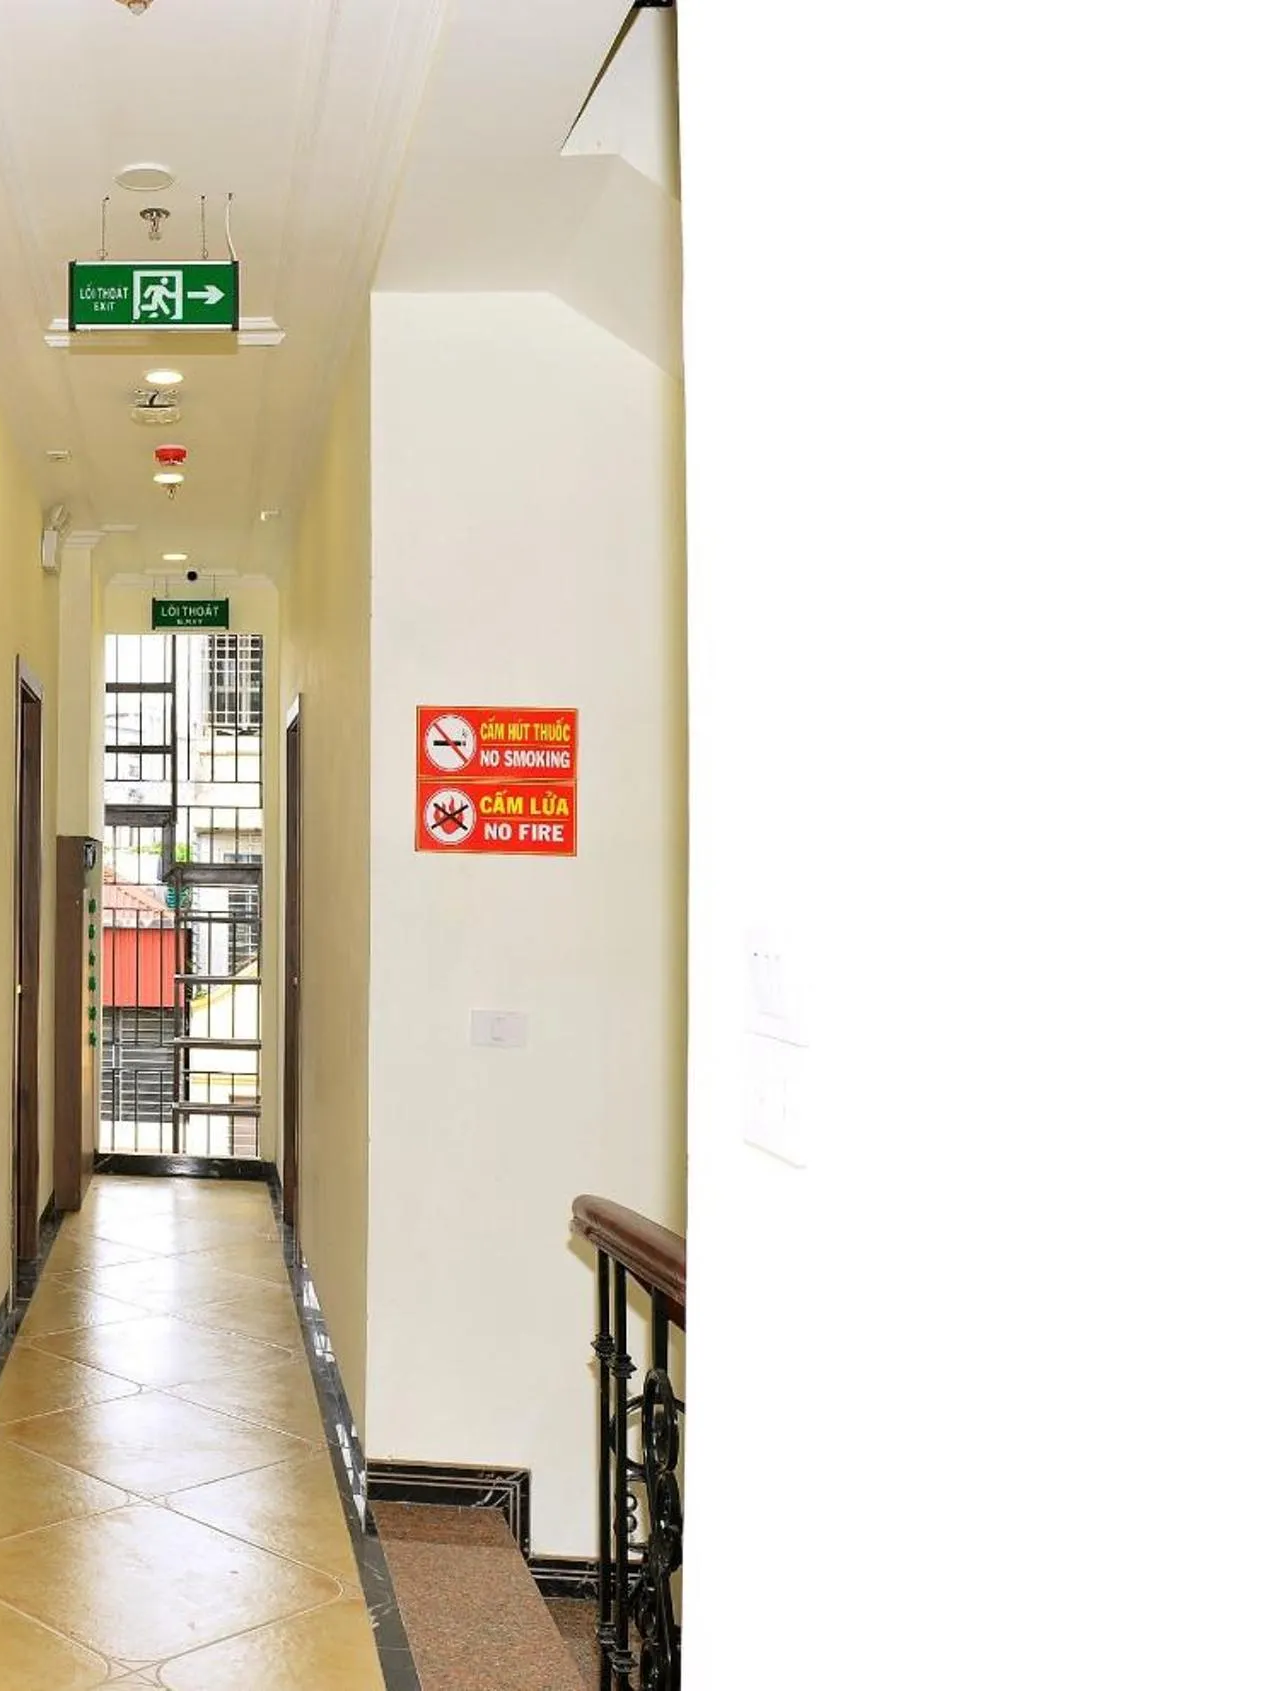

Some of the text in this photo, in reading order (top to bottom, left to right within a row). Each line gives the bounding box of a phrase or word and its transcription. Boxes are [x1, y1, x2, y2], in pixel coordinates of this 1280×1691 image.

[93, 301, 116, 312] EXIT
[480, 716, 570, 742] CẤM HÚT THUỐC
[480, 750, 570, 768] NO SMOKING
[480, 790, 569, 816] CẤM LỬA
[484, 823, 564, 842] NO FIRE
